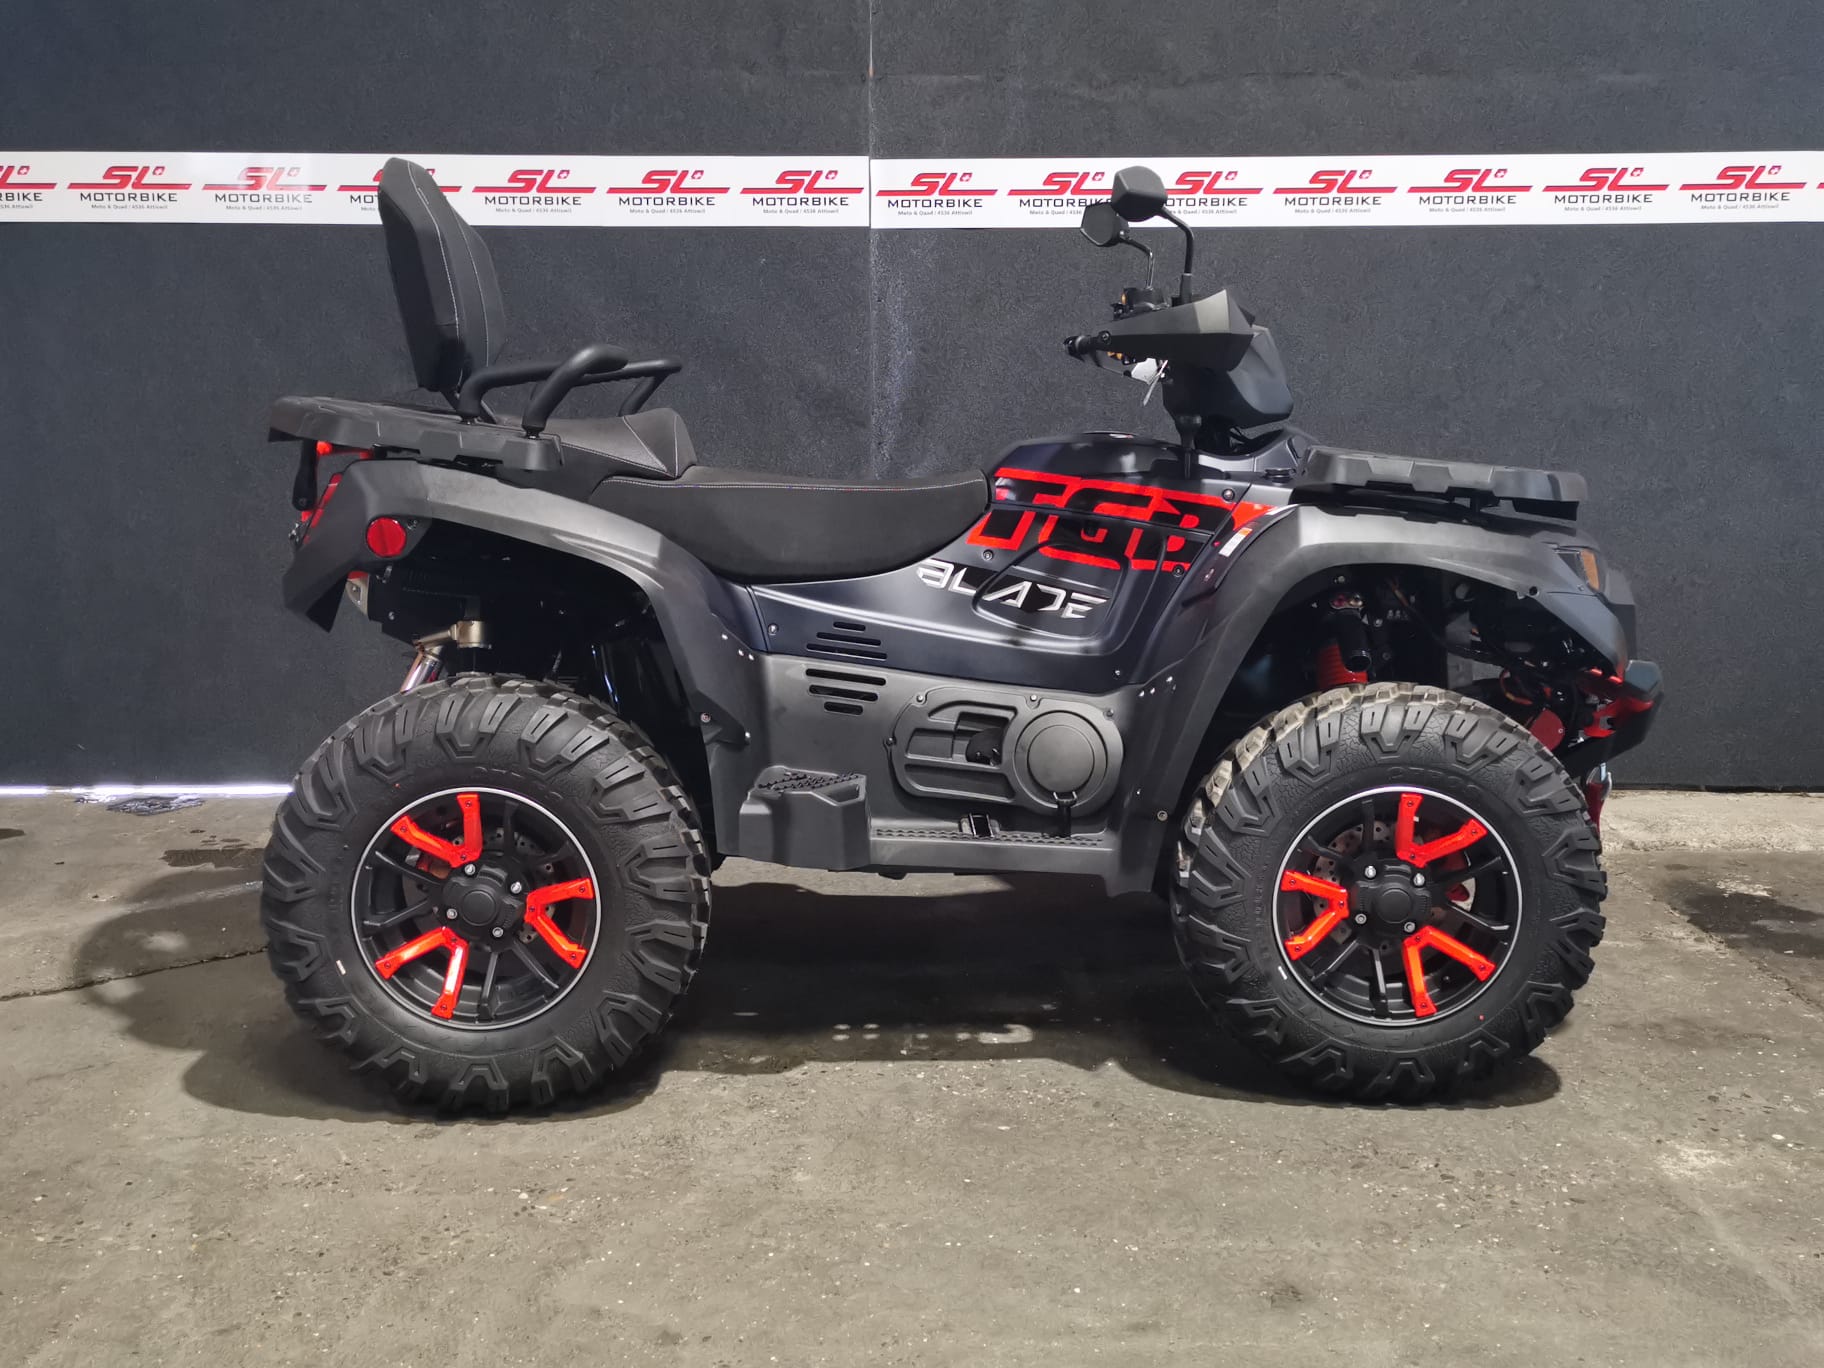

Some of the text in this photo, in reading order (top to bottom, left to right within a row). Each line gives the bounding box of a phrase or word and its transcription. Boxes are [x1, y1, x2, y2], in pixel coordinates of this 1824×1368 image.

[80, 192, 177, 202] MOTORBIKE
[215, 193, 313, 203] MOTORBIKE
[485, 196, 582, 206] MOTORBIKE
[619, 197, 715, 206] MOTORBIKE
[752, 197, 849, 206] MOTORBIKE
[1165, 197, 1248, 207] OTORBIKE
[1284, 196, 1382, 206] MOTORBIKE
[1419, 195, 1517, 205] MOTORBIKE
[1554, 194, 1653, 204] MOTORBIKE
[1691, 192, 1790, 202] MOTORBIKE
[887, 199, 983, 208] MOTORBIKE
[916, 558, 1107, 619] BLADE
